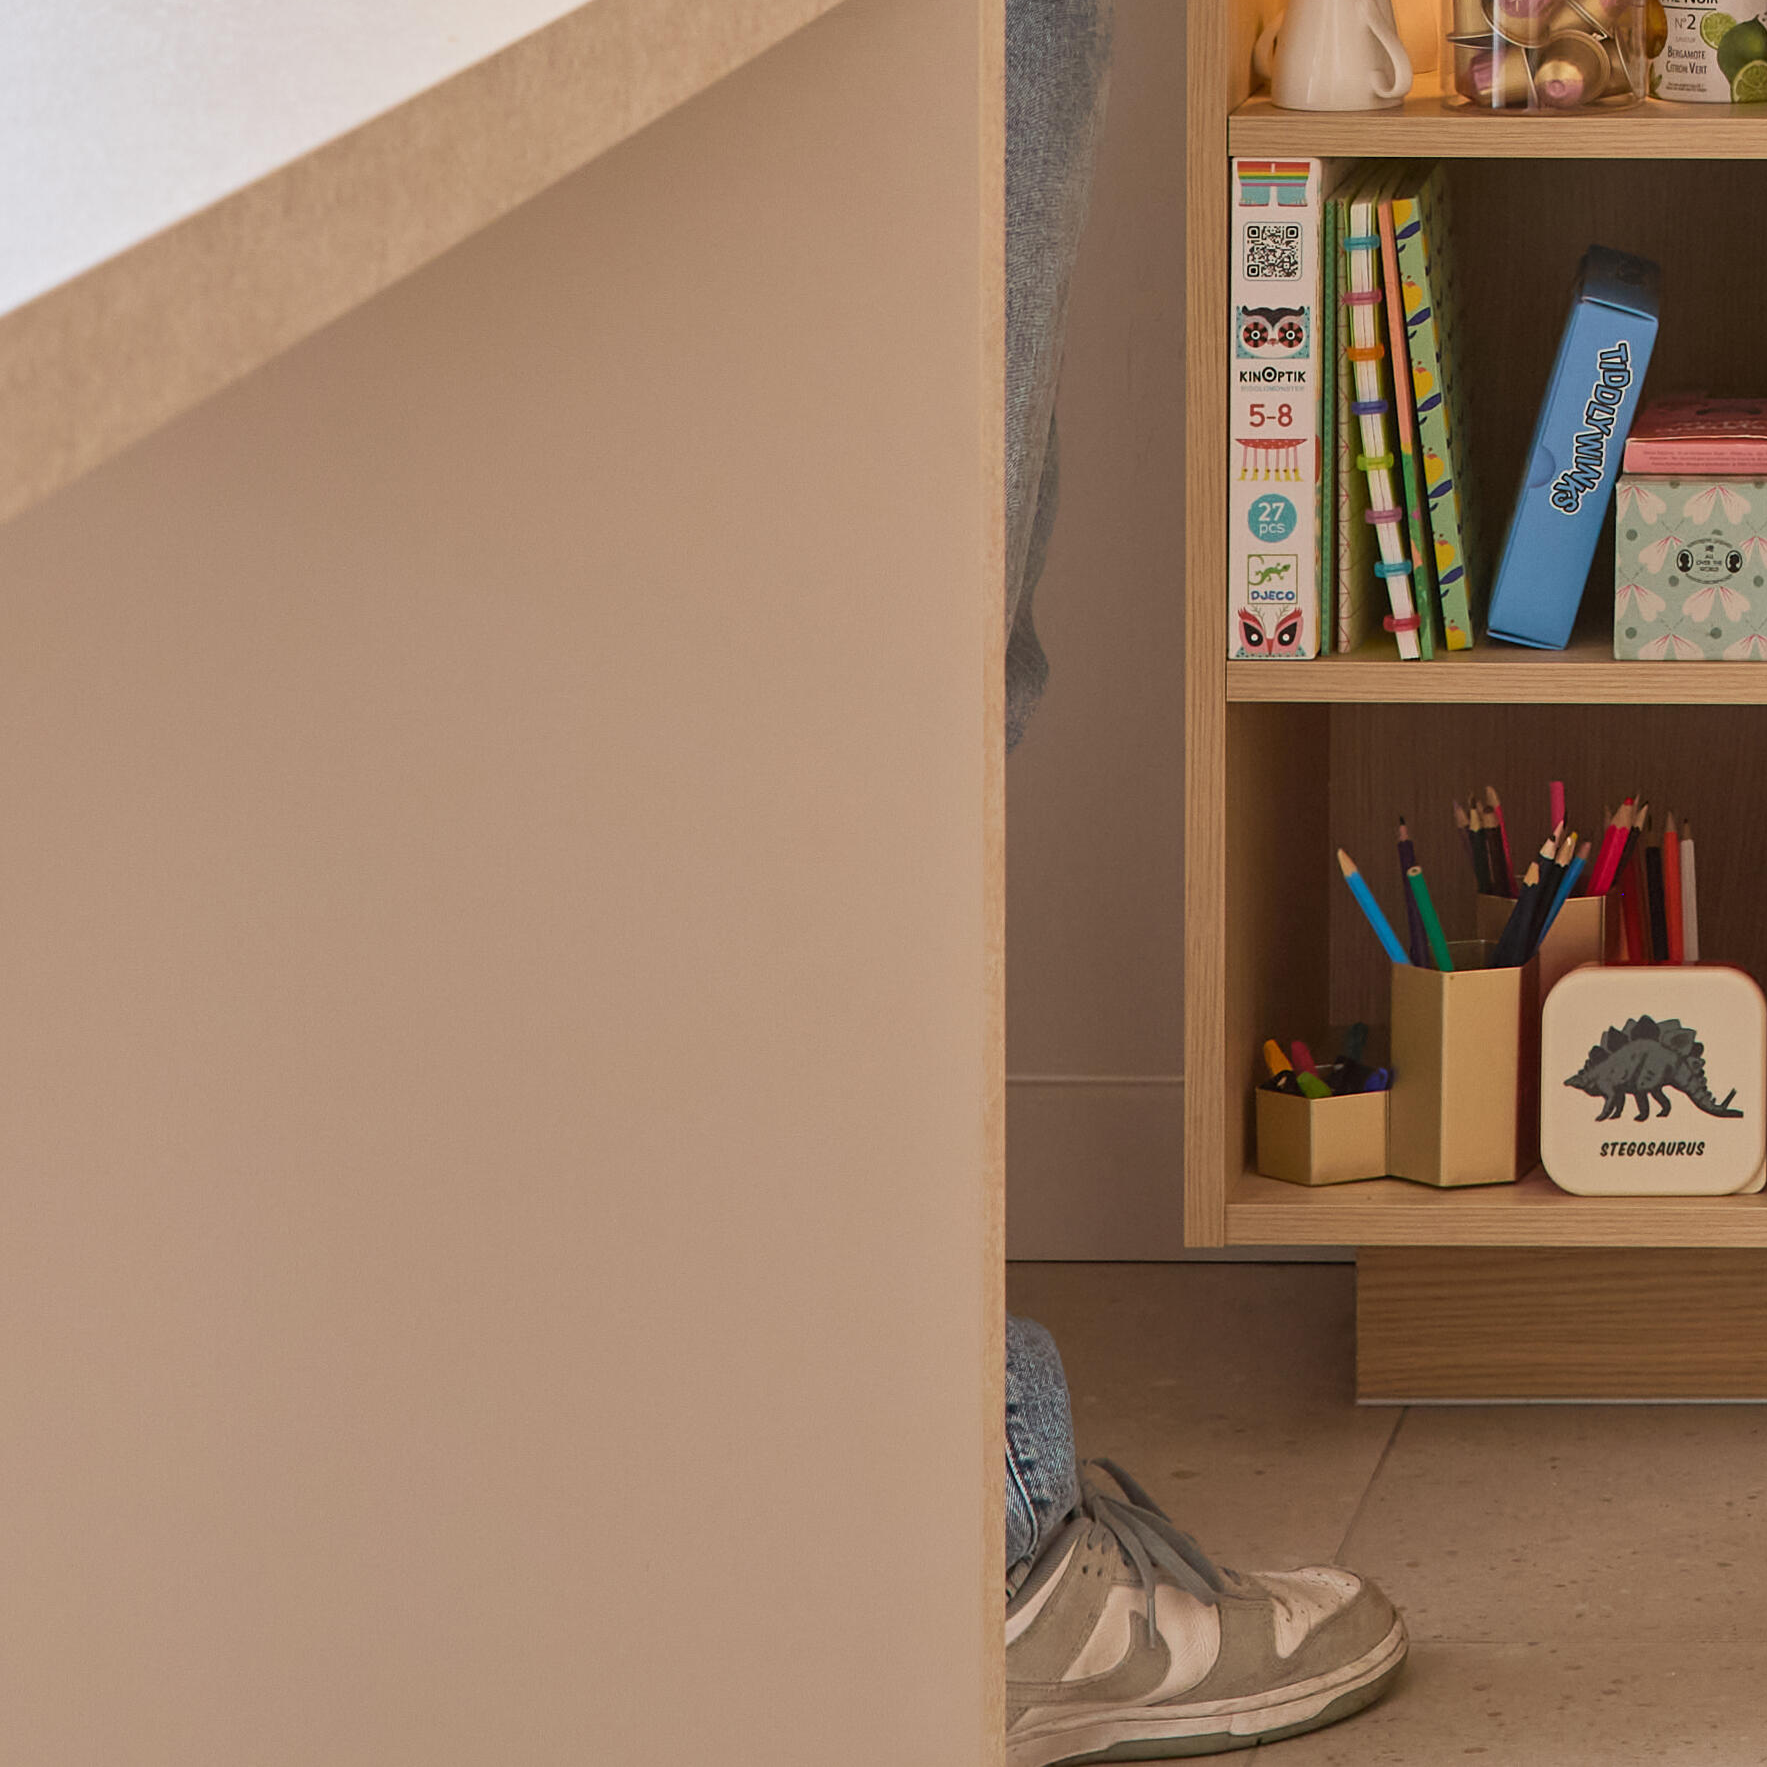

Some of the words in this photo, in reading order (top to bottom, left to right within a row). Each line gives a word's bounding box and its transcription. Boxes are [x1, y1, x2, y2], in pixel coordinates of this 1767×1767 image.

[1239, 366, 1306, 383] KINOPTIK
[1249, 403, 1293, 427] 5-8
[1550, 340, 1632, 515] TIDDLYWINKS
[1258, 501, 1285, 522] 27
[1259, 522, 1285, 537] pcs
[1250, 589, 1296, 602] DJECO
[1600, 1141, 1706, 1157] STEGOSAURUS
